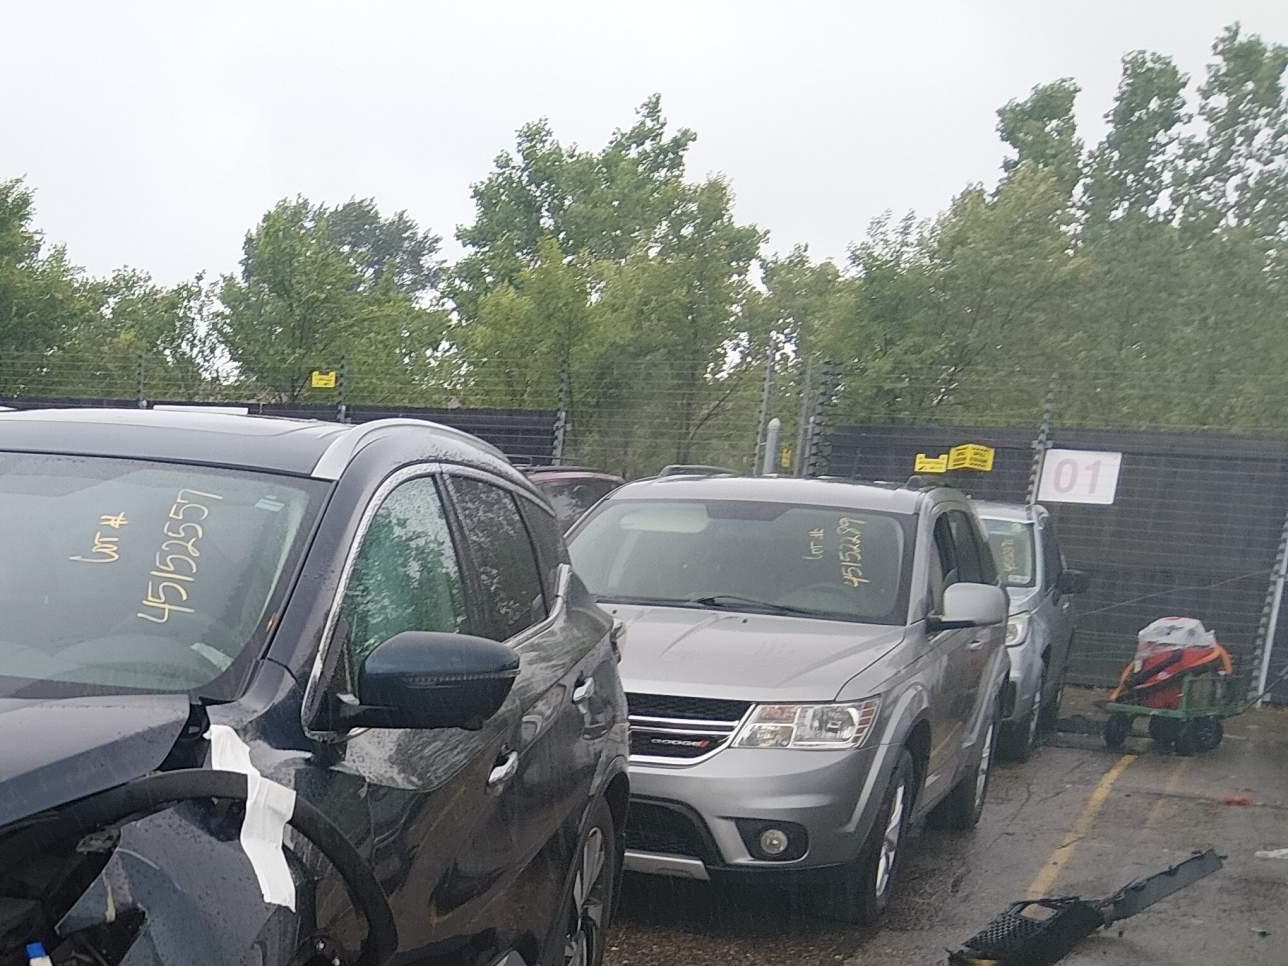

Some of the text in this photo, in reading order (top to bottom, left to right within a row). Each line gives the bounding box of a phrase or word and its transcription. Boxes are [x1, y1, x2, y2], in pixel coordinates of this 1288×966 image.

[1054, 458, 1102, 495] 01
[99, 511, 129, 529] #
[137, 488, 224, 624] 45152557
